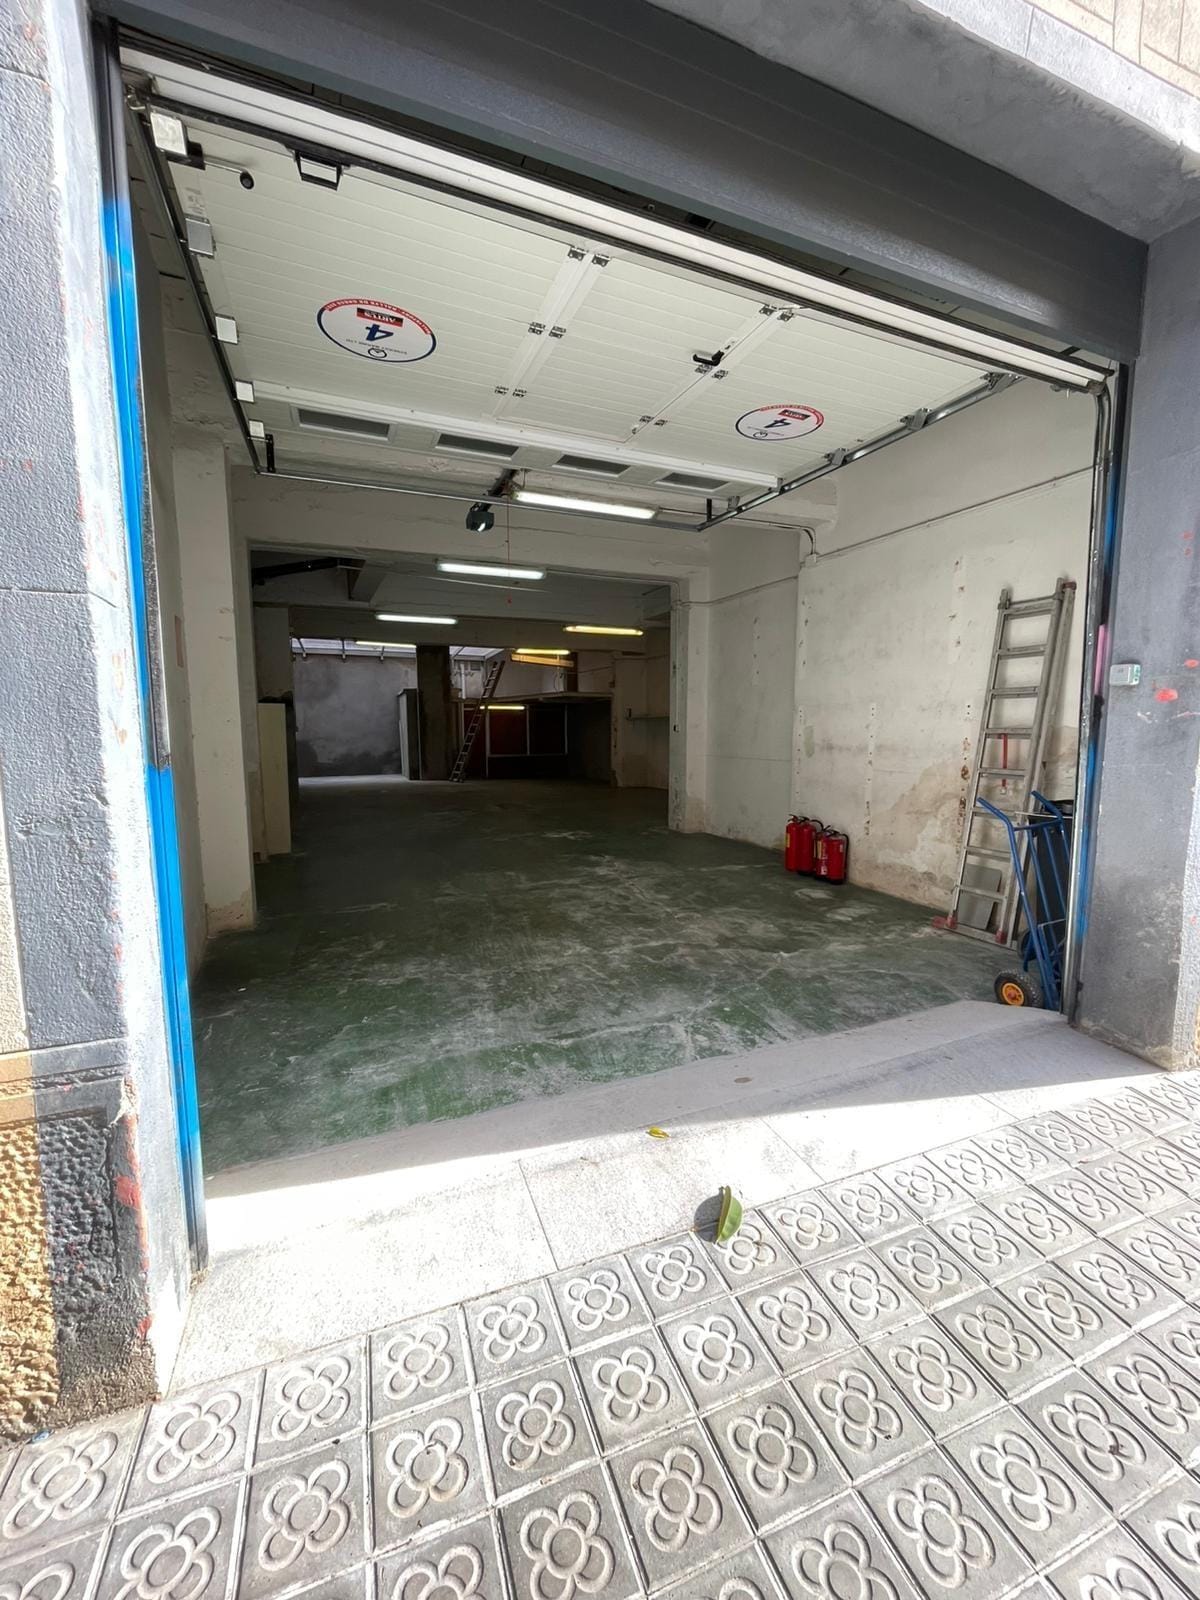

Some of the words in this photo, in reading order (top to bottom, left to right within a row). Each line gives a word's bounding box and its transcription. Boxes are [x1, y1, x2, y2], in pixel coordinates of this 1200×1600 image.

[364, 310, 397, 324] ARTUS
[365, 323, 394, 342] 4
[764, 418, 792, 429] 4
